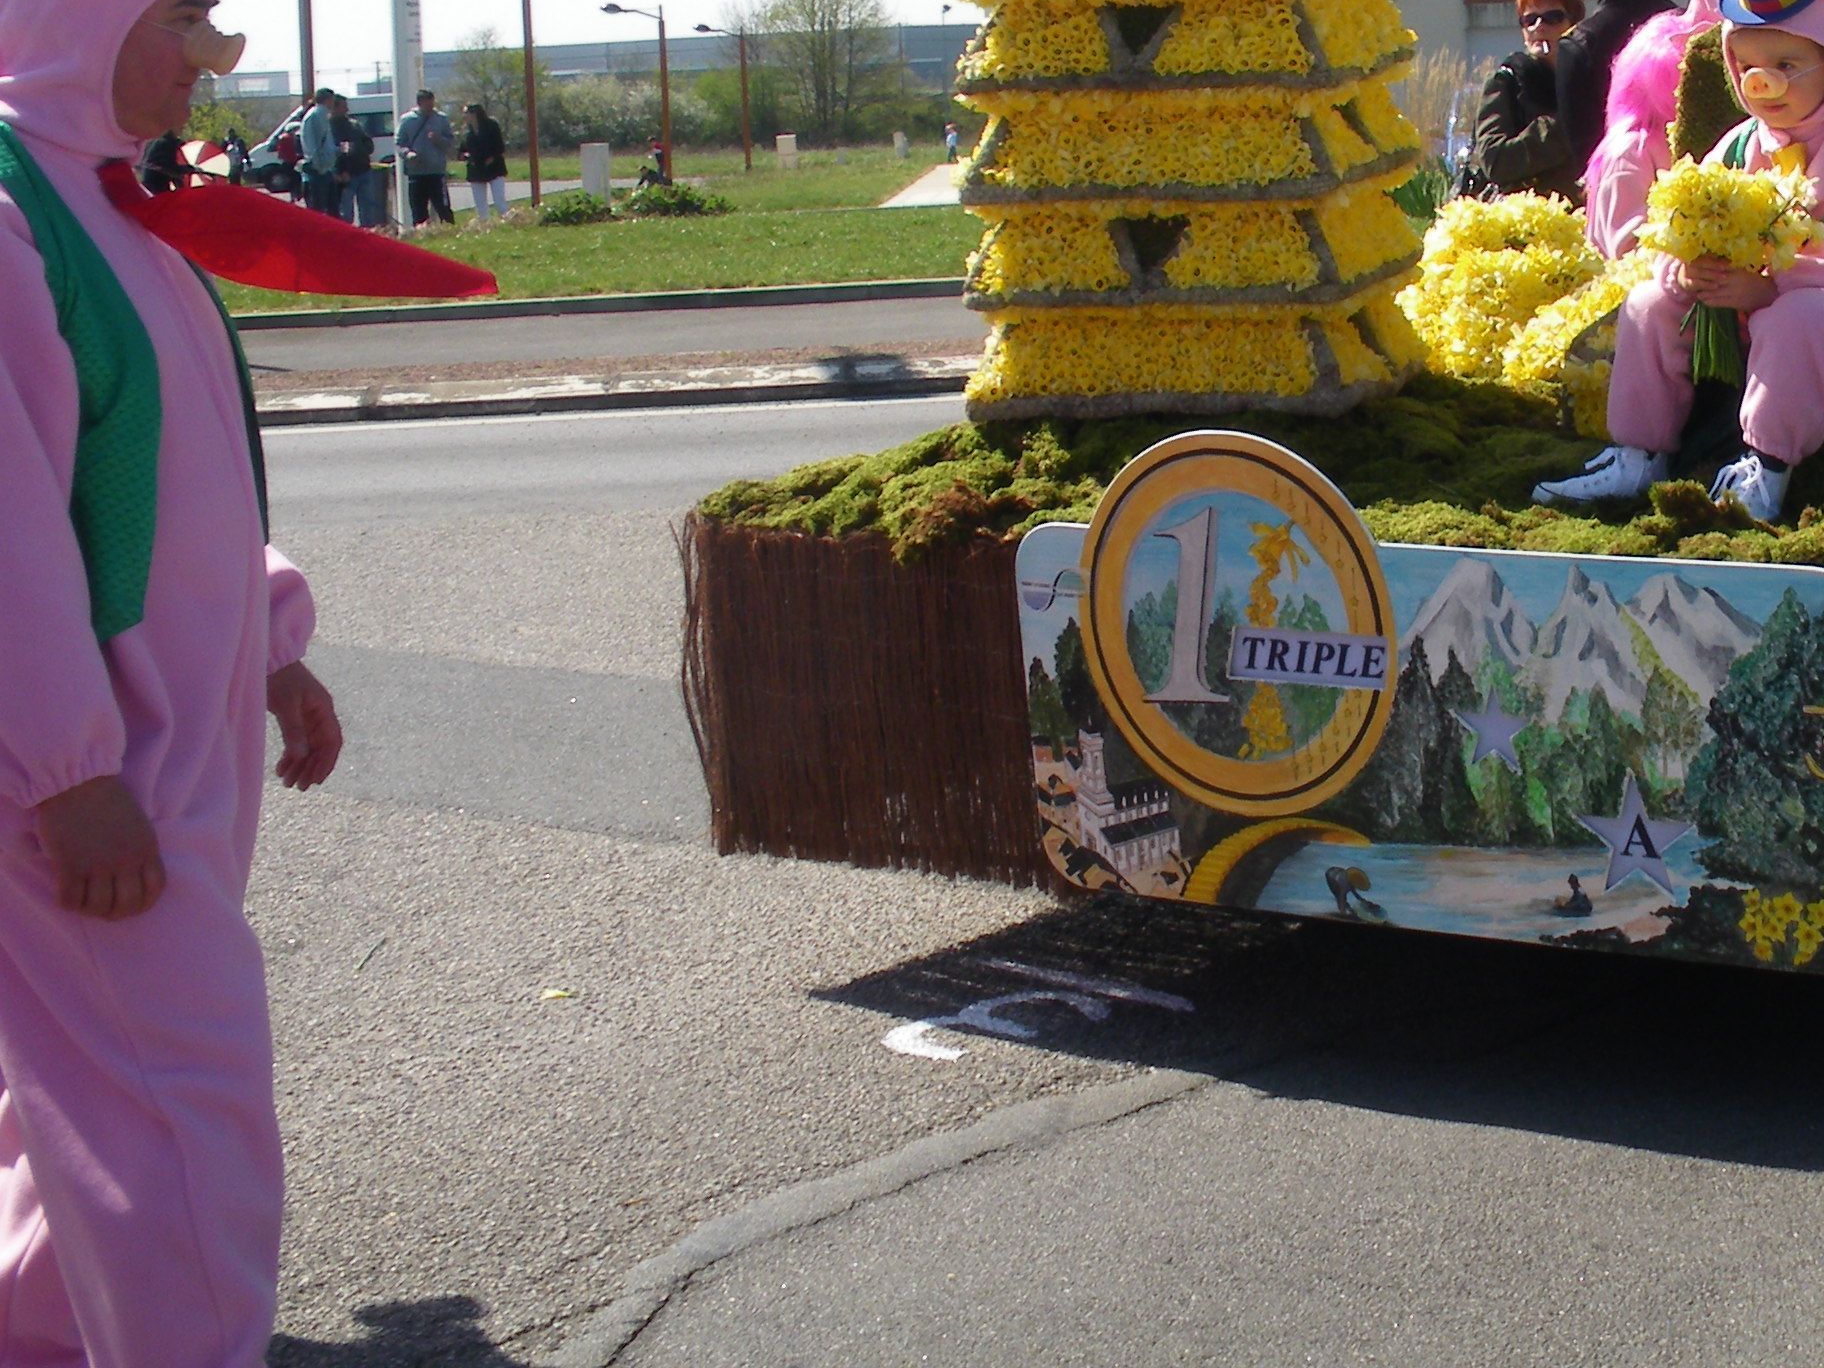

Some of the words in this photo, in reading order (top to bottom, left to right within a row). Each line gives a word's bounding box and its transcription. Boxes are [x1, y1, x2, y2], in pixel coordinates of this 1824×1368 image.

[1143, 506, 1230, 703] 1
[1242, 636, 1385, 679] TRIPLE
[1620, 814, 1662, 860] A
